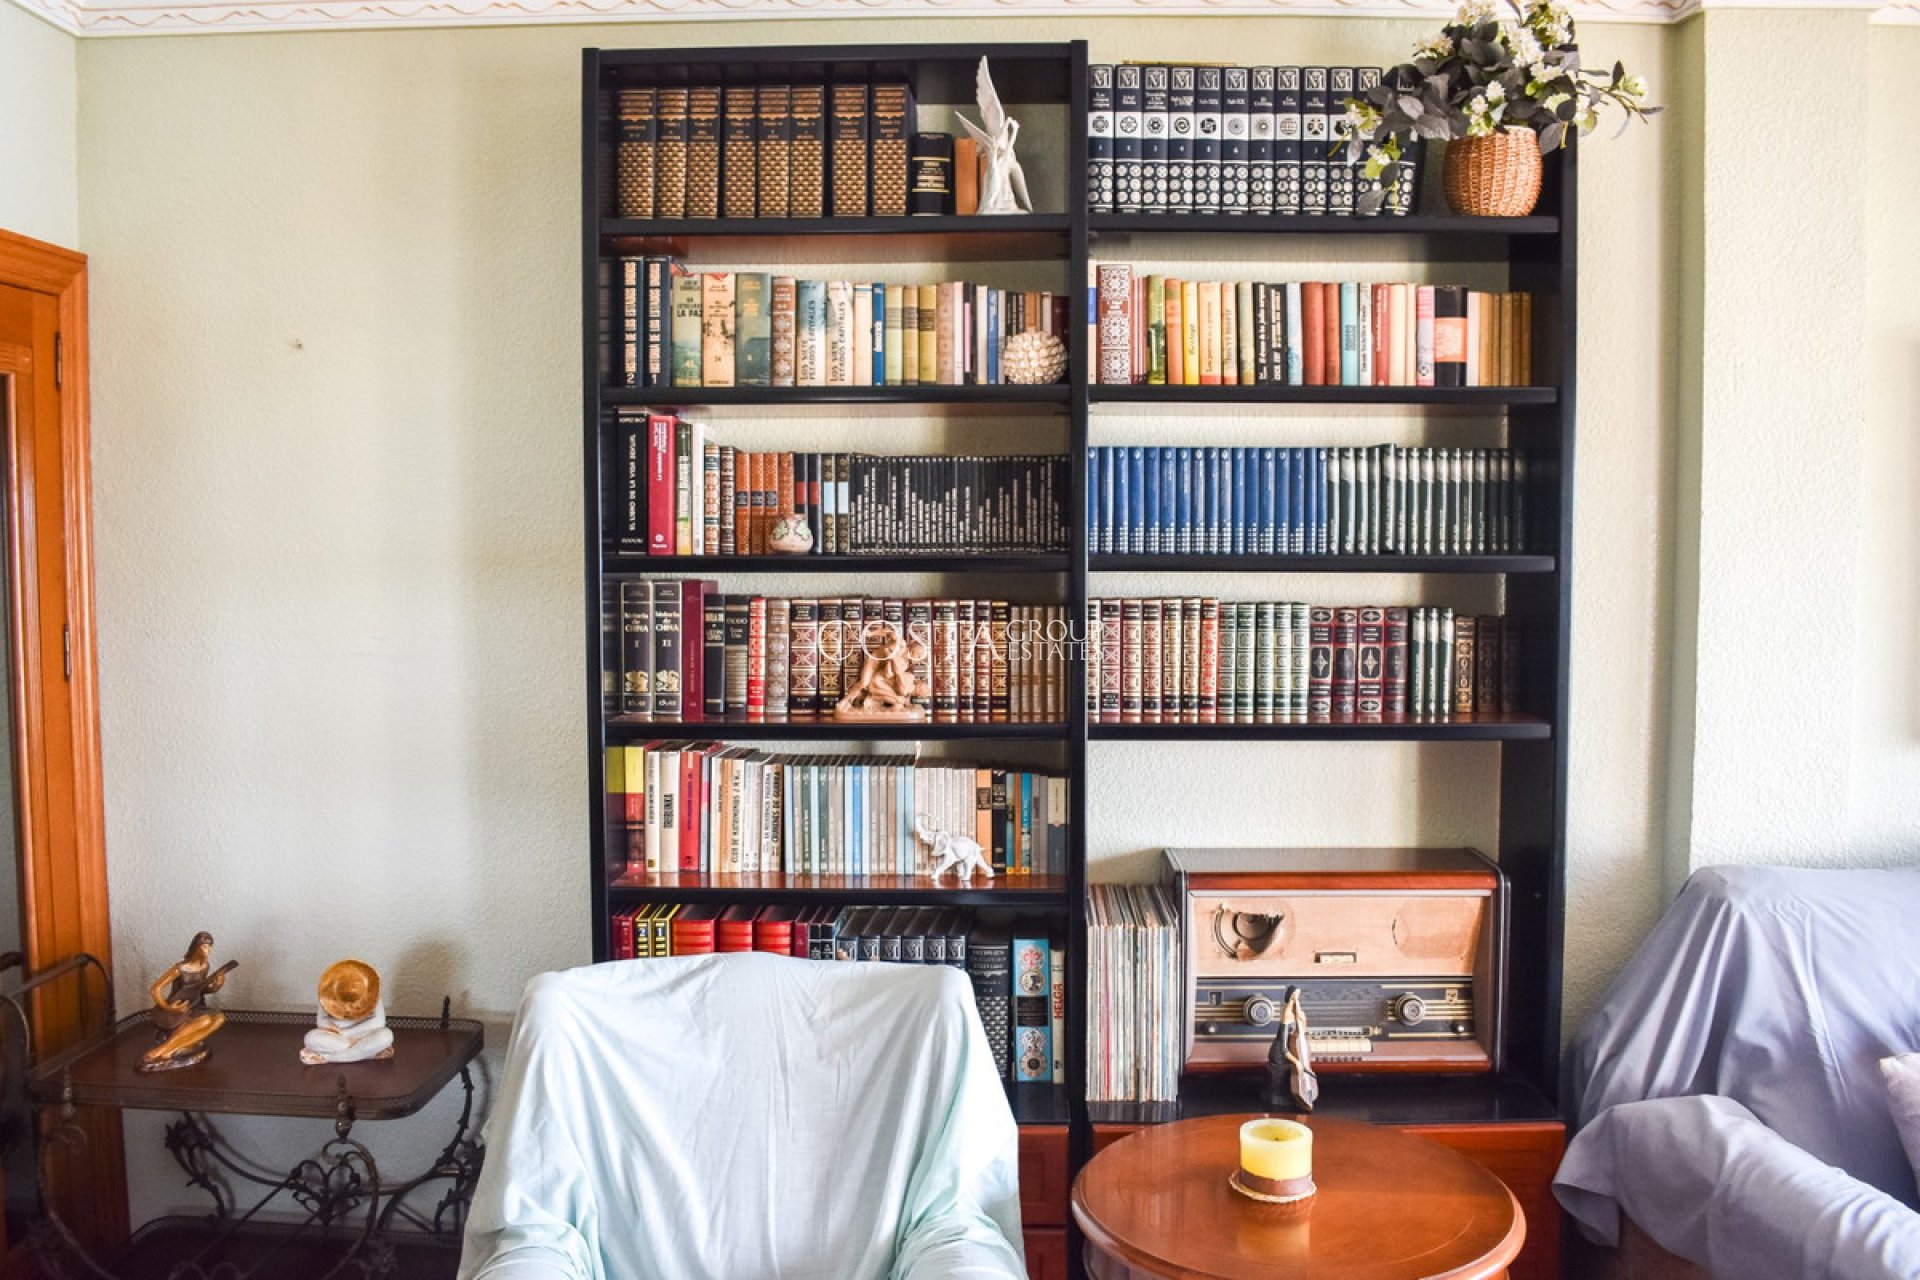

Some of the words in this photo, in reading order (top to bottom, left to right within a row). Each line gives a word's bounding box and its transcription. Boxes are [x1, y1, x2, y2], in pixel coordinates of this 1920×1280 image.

[626, 373, 635, 384] 2
[630, 479, 637, 488] LA
[630, 490, 637, 500] DE
[1053, 983, 1063, 1019] HELGA
